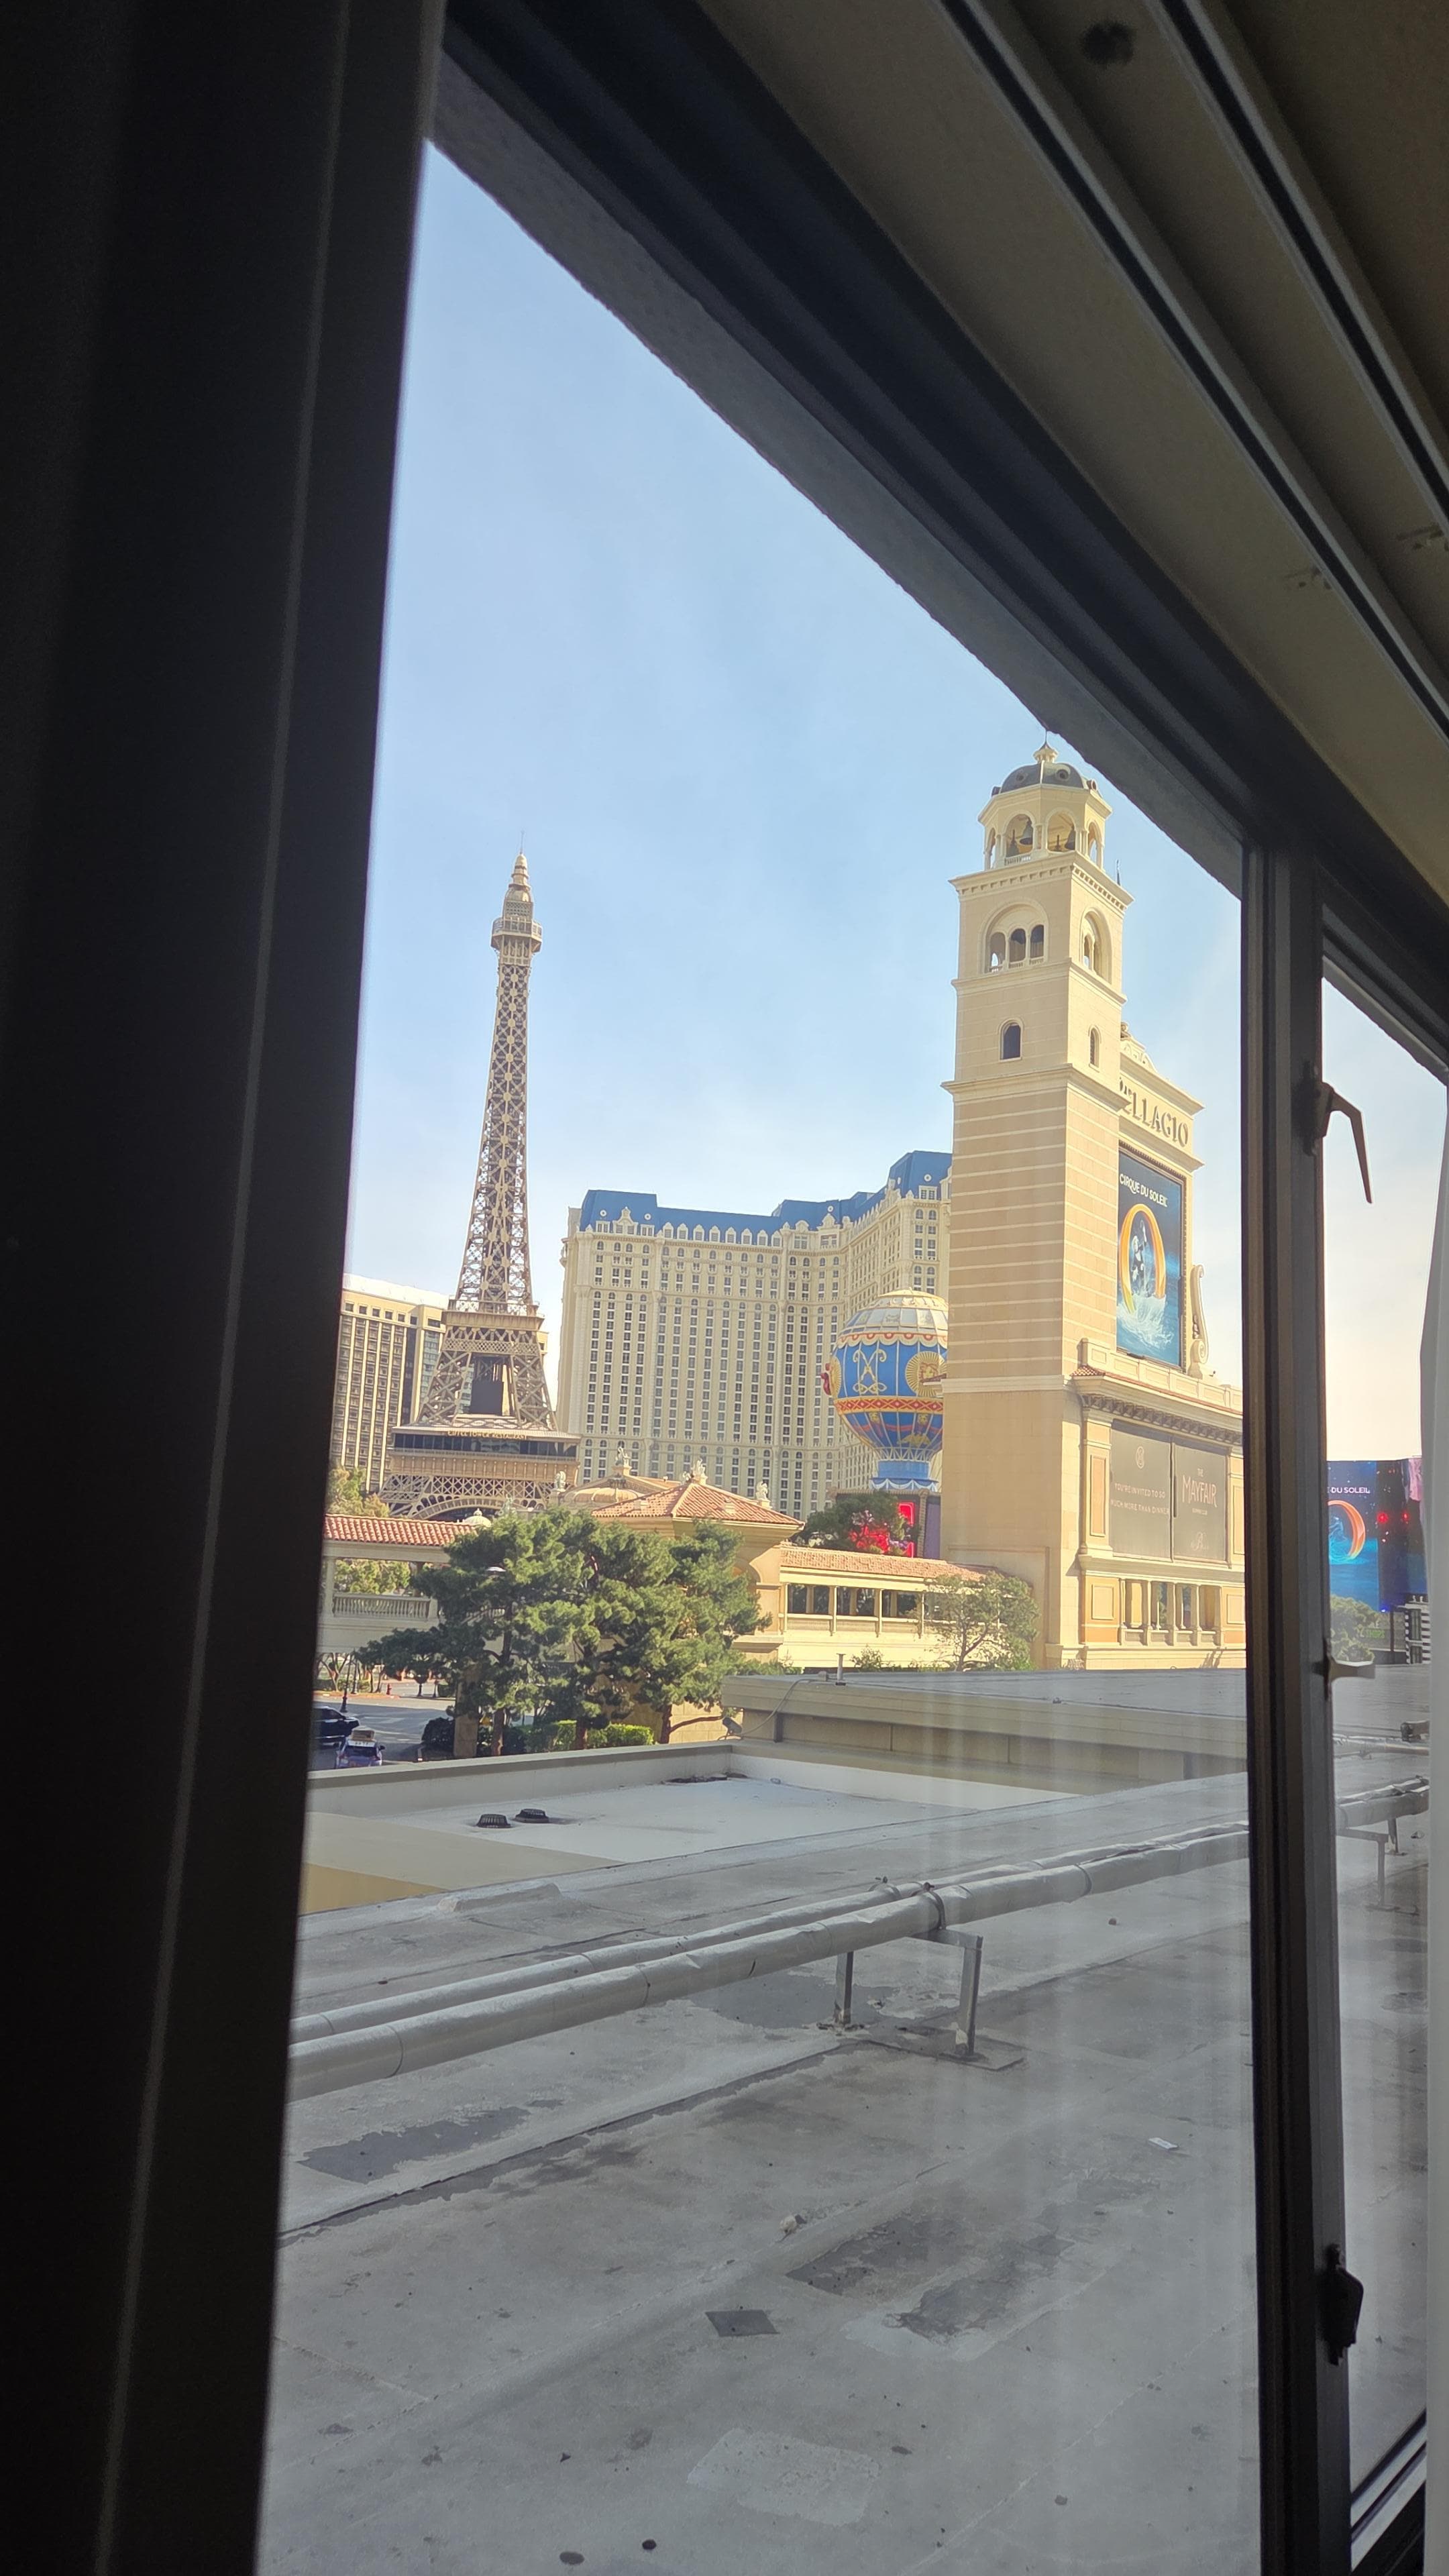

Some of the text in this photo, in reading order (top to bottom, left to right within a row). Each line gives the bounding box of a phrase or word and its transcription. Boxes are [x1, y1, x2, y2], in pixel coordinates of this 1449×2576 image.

[1120, 1173, 1168, 1208] CIRQUE DU SOLEIL
[1124, 1502, 1138, 1511] MORE
[1138, 1504, 1151, 1513] THAN
[1182, 1474, 1217, 1508] MAYFAIR
